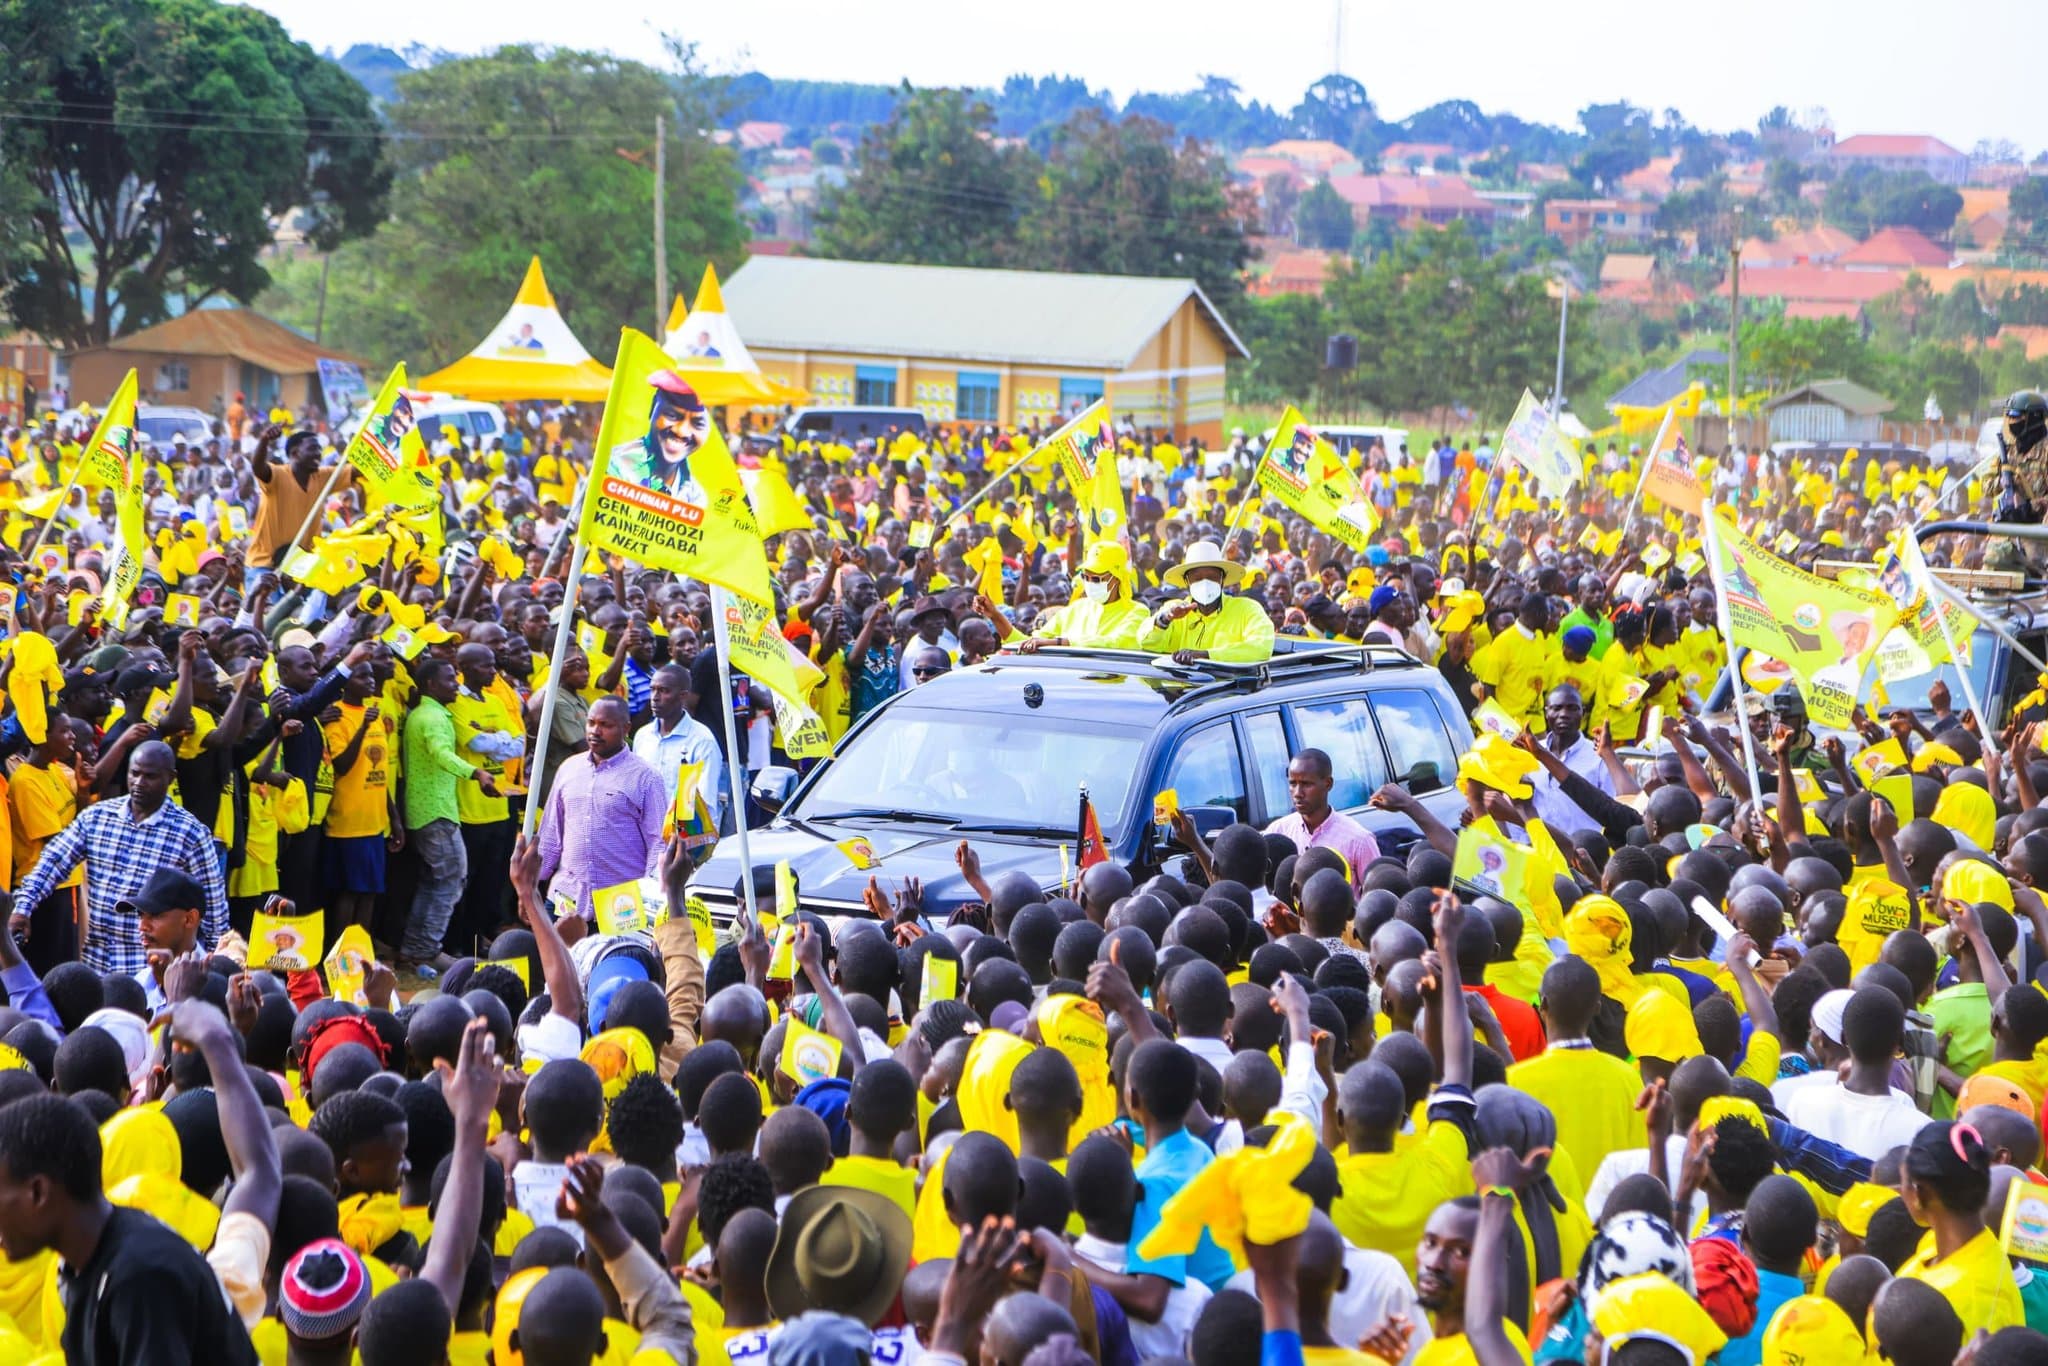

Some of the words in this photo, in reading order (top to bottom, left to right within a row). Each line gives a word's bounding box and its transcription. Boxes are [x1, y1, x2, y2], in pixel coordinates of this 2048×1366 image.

[597, 496, 631, 518] GEN.
[636, 510, 704, 542] MUHOOZI
[607, 481, 670, 512] CHAIRMAN
[671, 500, 700, 522] PLU
[594, 511, 698, 556] KAINERUGABA
[611, 533, 649, 556] NEXT
[1739, 538, 1822, 587] PROTECTING
[1827, 581, 1853, 595] THE
